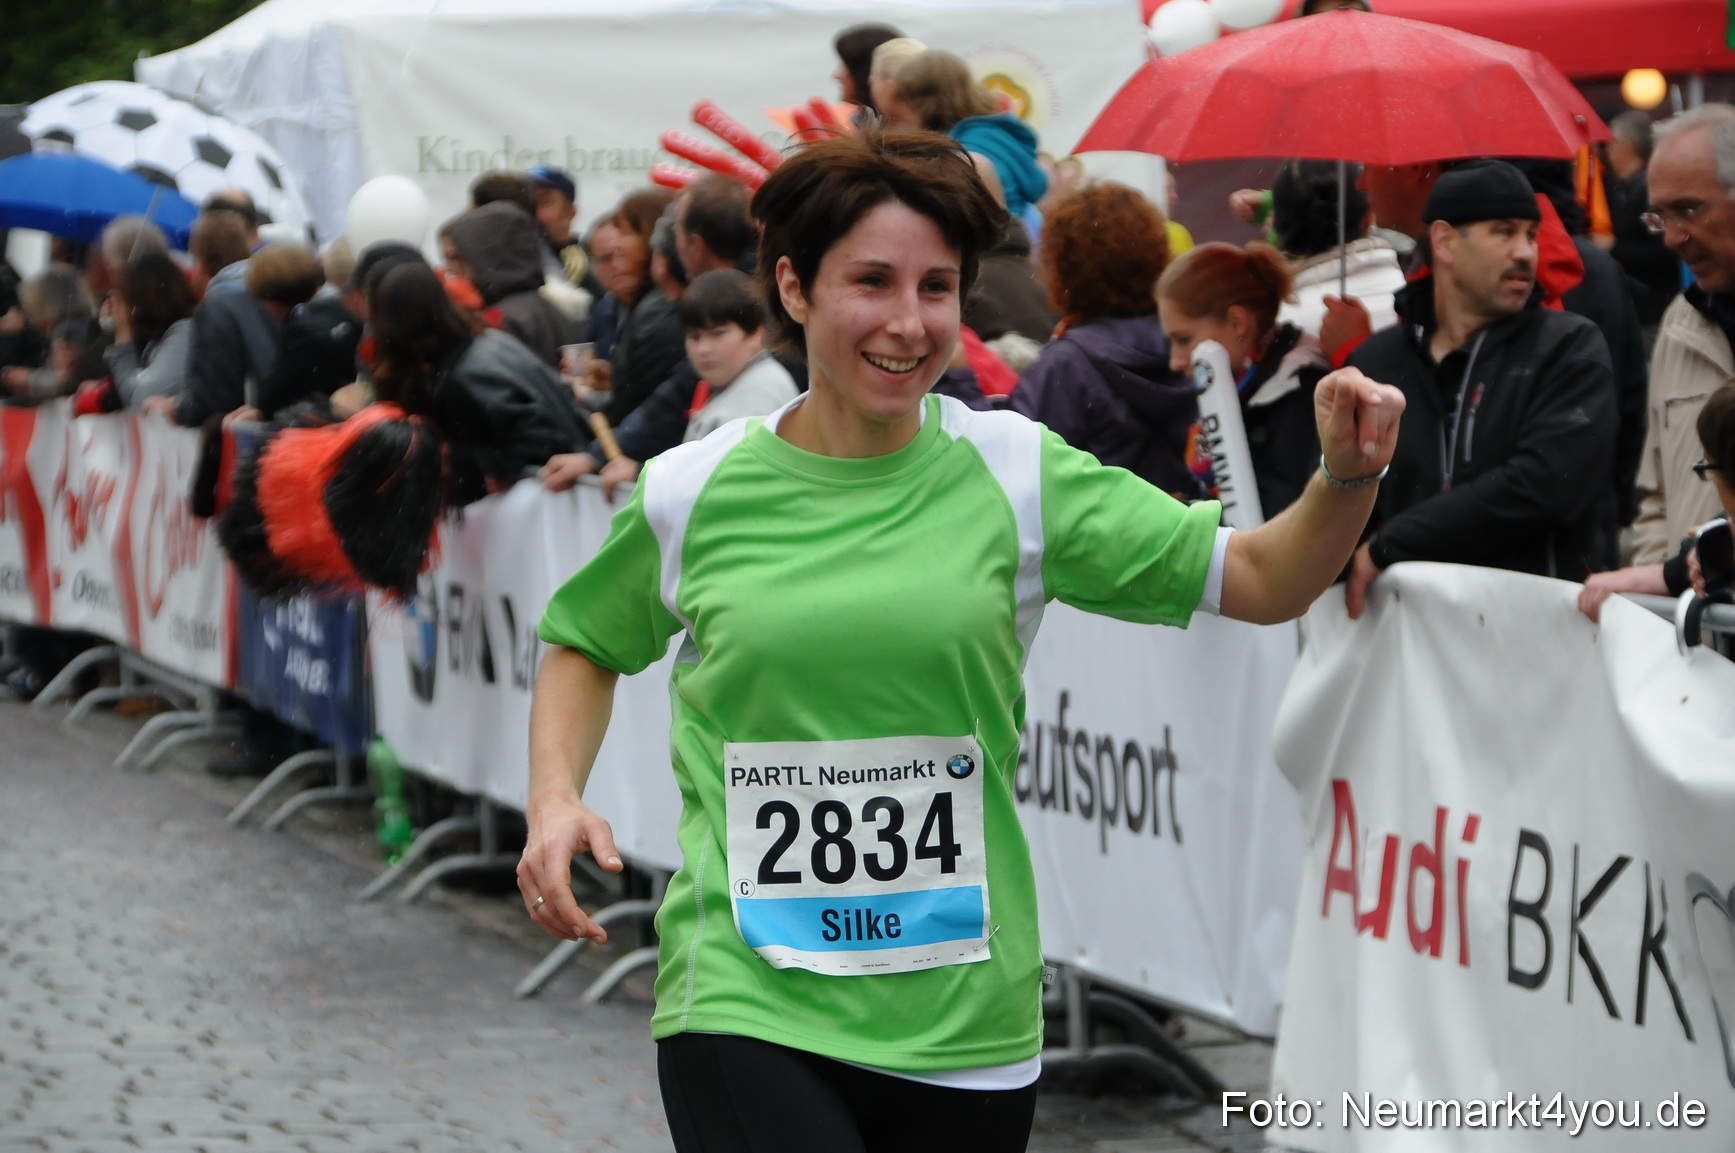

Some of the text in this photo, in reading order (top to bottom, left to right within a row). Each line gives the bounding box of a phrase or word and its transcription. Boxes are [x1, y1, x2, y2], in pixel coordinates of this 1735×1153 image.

[415, 134, 552, 173] Kinder
[730, 759, 936, 787] PARTL Neumarkt
[1014, 688, 1184, 855] aufsport
[755, 791, 962, 885] 2834
[740, 881, 750, 896] C
[821, 908, 902, 942] Silke
[1322, 778, 1697, 1043] Audi BKK
